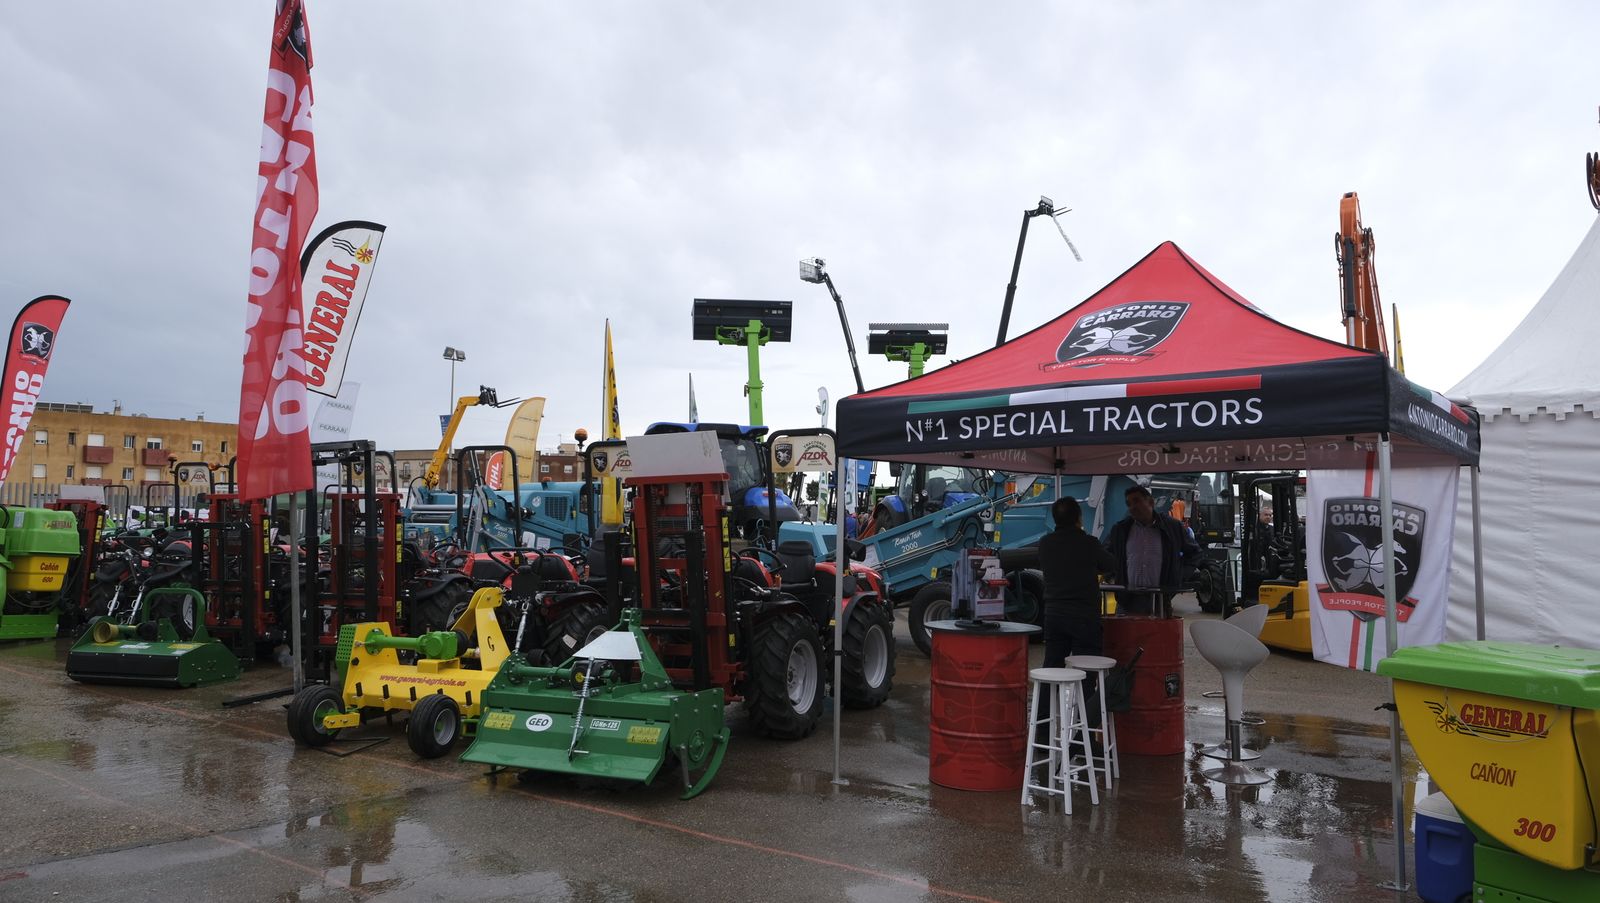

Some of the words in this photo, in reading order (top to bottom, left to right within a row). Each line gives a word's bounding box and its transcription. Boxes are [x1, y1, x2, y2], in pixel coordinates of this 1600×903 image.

[1079, 309, 1177, 329] CARRARO
[1085, 304, 1182, 322] ANTONIO
[1051, 357, 1097, 371] TRACTOR
[959, 409, 1074, 440] SPECIAL
[1083, 397, 1264, 433] TRACTORS
[610, 459, 633, 472] AZO
[795, 451, 833, 467] AZOR
[901, 541, 919, 552] 2000
[40, 562, 59, 571] Cañón
[528, 717, 550, 727] GEO
[1460, 703, 1549, 736] GENERAL
[1470, 762, 1517, 788] CAÑON
[1513, 817, 1557, 844] 300
